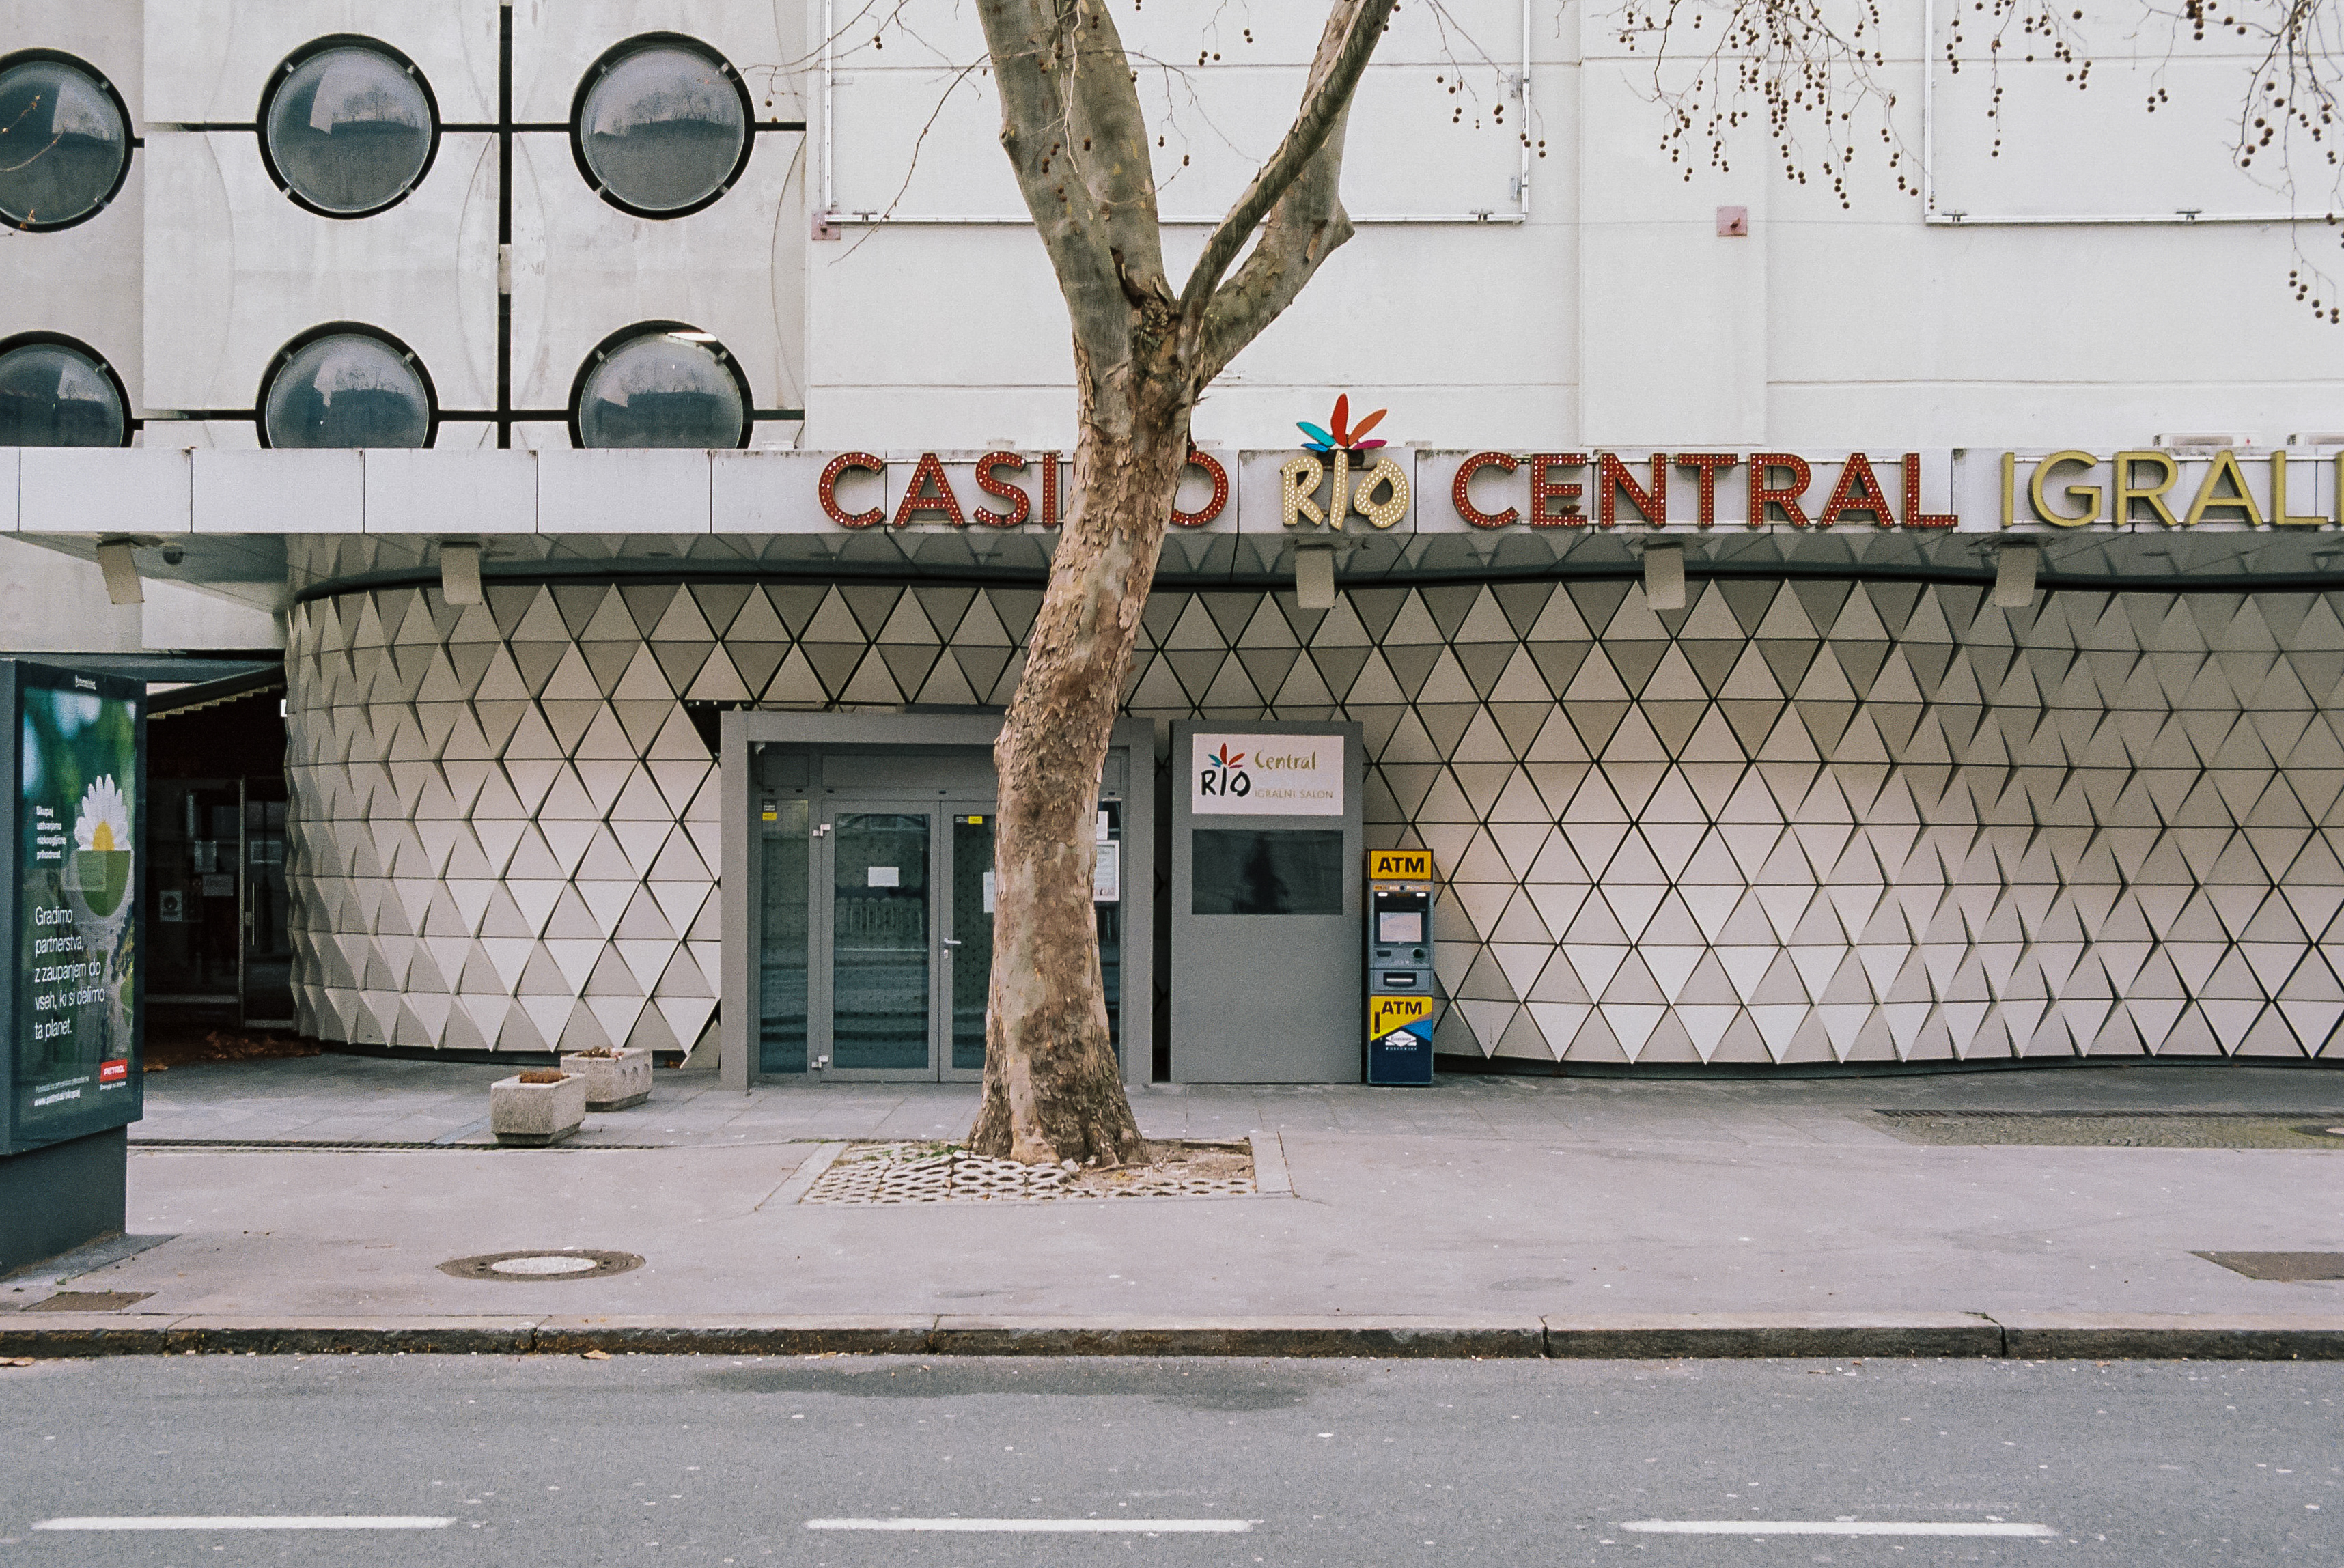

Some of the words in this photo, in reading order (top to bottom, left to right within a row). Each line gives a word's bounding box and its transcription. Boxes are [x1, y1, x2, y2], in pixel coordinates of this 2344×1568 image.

[818, 450, 1229, 529] CASIO
[1280, 449, 1410, 531] RIO
[1451, 451, 1959, 529] CENTRAL
[2000, 449, 2344, 528] IGRAL
[1254, 749, 1317, 770] Central
[1201, 766, 1251, 797] RIO
[1255, 789, 1296, 799] IGRALNI
[1300, 789, 1333, 799] SALON
[1377, 856, 1425, 873] ATM
[36, 906, 73, 926] Gradimo
[36, 934, 84, 959] partnerstva,
[34, 968, 40, 983] z
[42, 960, 87, 984] zaupanjem
[89, 957, 101, 977] do
[35, 990, 57, 1011] vseh,
[59, 989, 67, 1008] ki
[69, 988, 76, 1007] si
[77, 985, 105, 1005] delimo
[1381, 1000, 1422, 1016] ATM
[34, 1022, 43, 1039] ta
[45, 1016, 72, 1043] planet.
